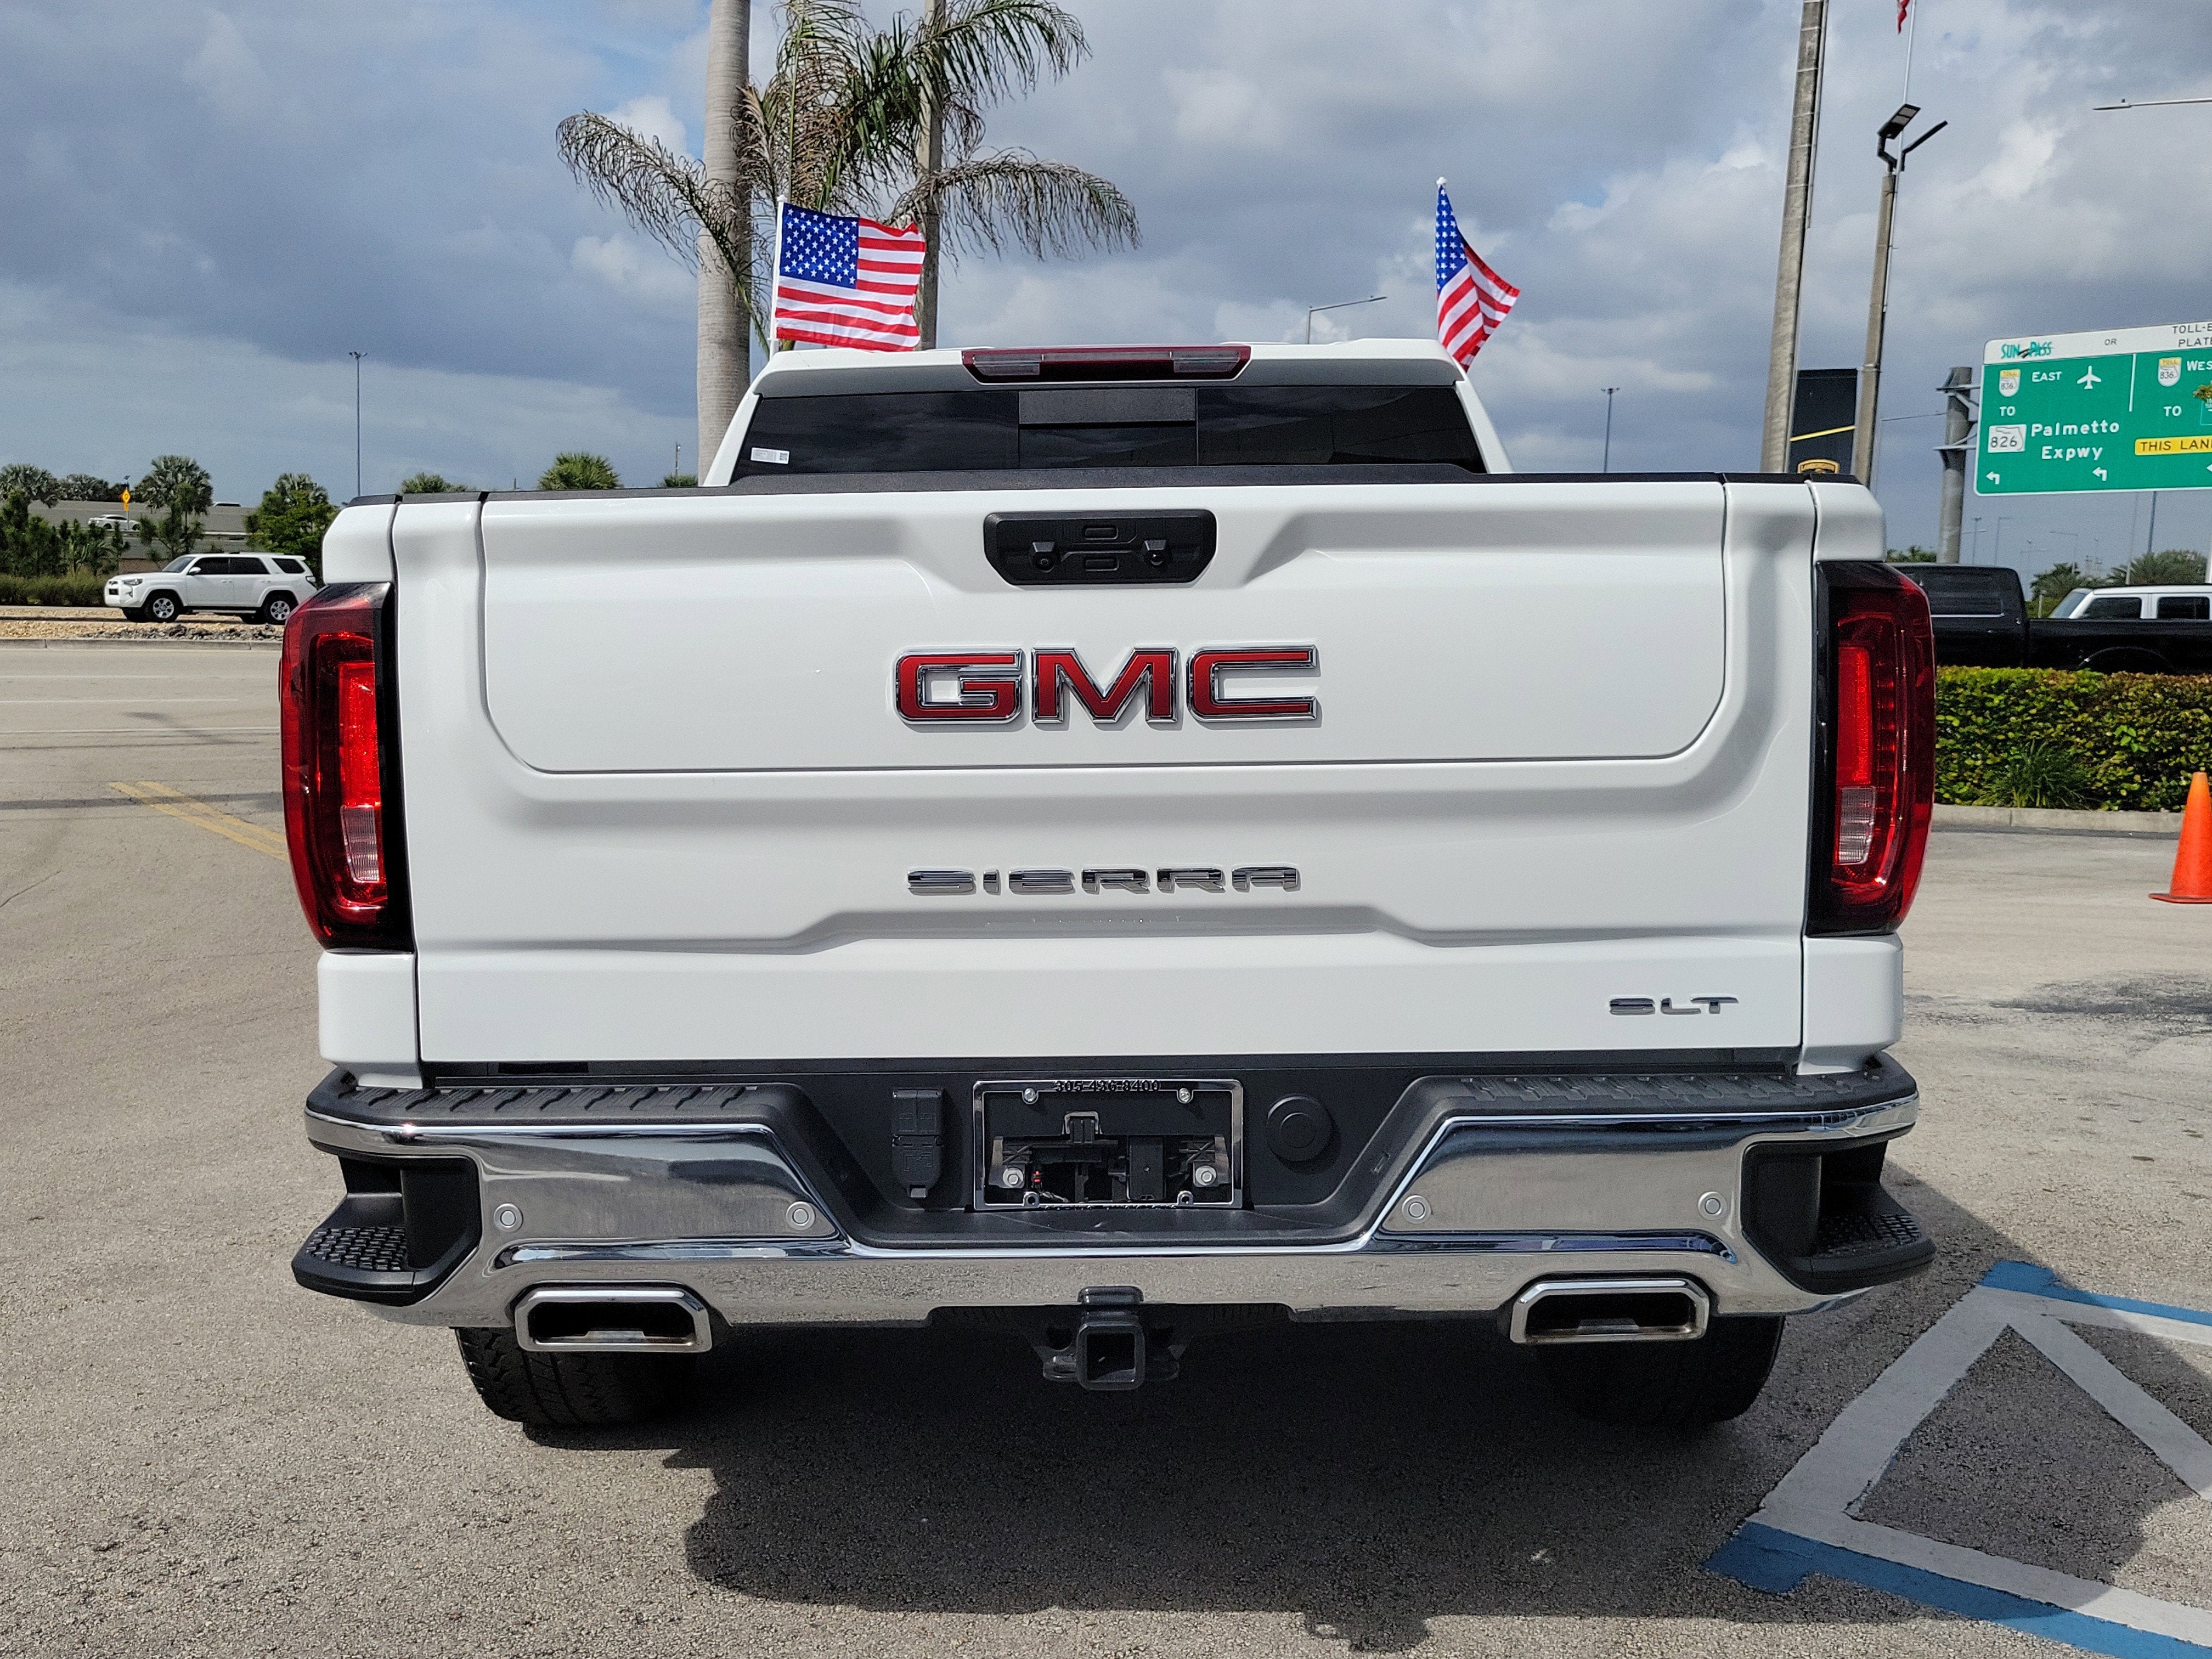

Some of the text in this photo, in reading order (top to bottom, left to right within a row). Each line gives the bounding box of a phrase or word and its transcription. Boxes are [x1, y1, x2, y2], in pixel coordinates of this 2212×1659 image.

[2032, 371, 2062, 382] EAST
[1999, 406, 2016, 416] TO
[2163, 405, 2182, 417] TO
[2031, 419, 2120, 437] Palmetto
[1990, 436, 2018, 448] 826
[2140, 438, 2212, 452] THIS LAN
[2041, 445, 2103, 461] Expwy
[894, 644, 1318, 724] GMC
[906, 864, 1301, 895] SIERRA
[1609, 996, 1739, 1015] SLT
